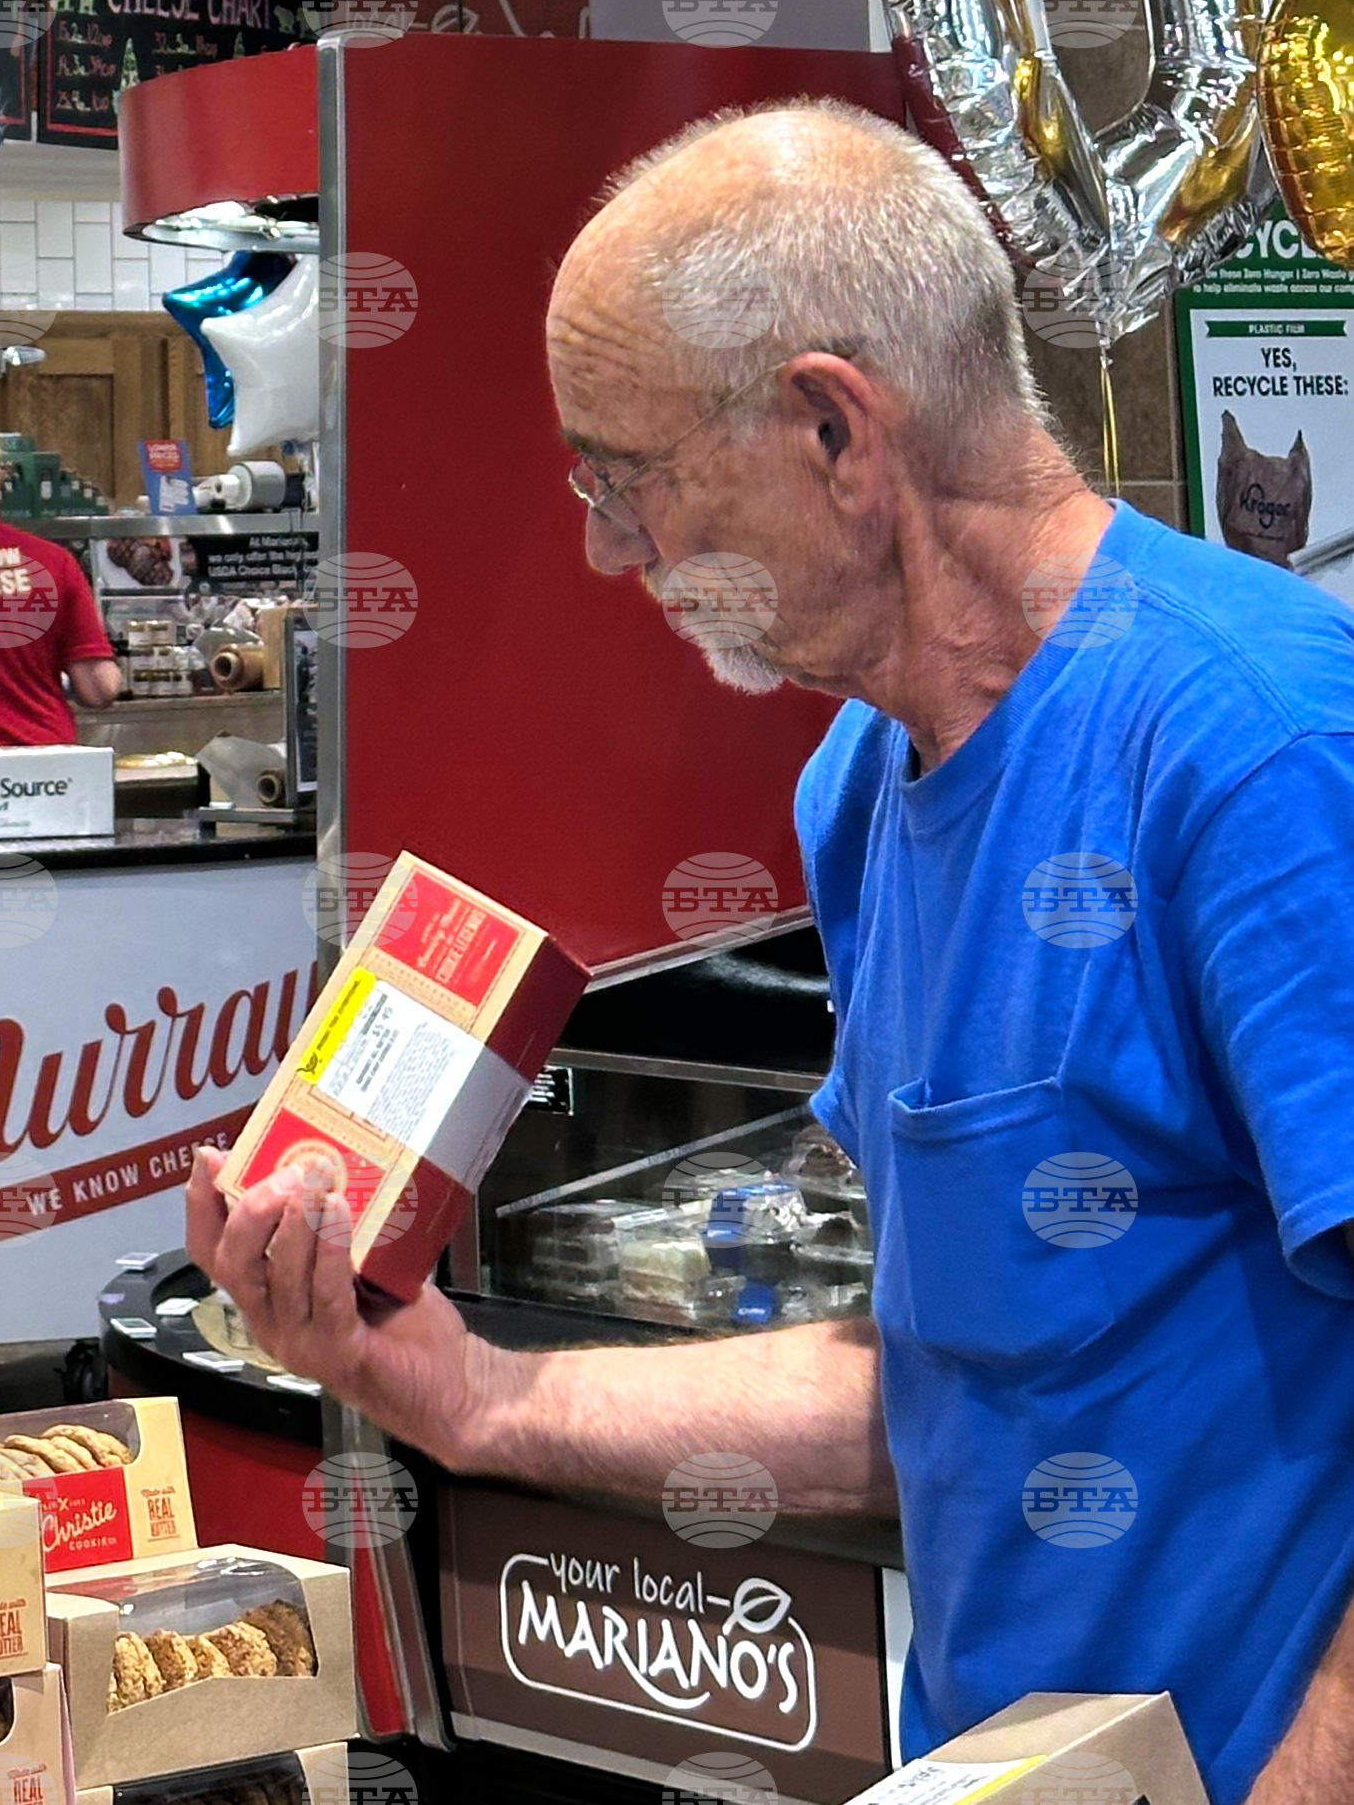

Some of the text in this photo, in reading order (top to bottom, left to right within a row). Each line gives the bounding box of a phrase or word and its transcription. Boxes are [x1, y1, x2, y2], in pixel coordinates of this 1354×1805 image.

[1248, 323, 1305, 334] PLASTIC FILM
[1261, 348, 1297, 372] YES,
[1212, 375, 1349, 397] RECYCLE THESE:
[1239, 483, 1291, 529] Kroger
[25, 1187, 63, 1216] WE
[72, 1162, 139, 1203] KNOW
[41, 1501, 118, 1552] Christie
[147, 1496, 175, 1521] REAL
[549, 1552, 705, 1614] your local
[518, 1580, 798, 1713] MARIANO'S
